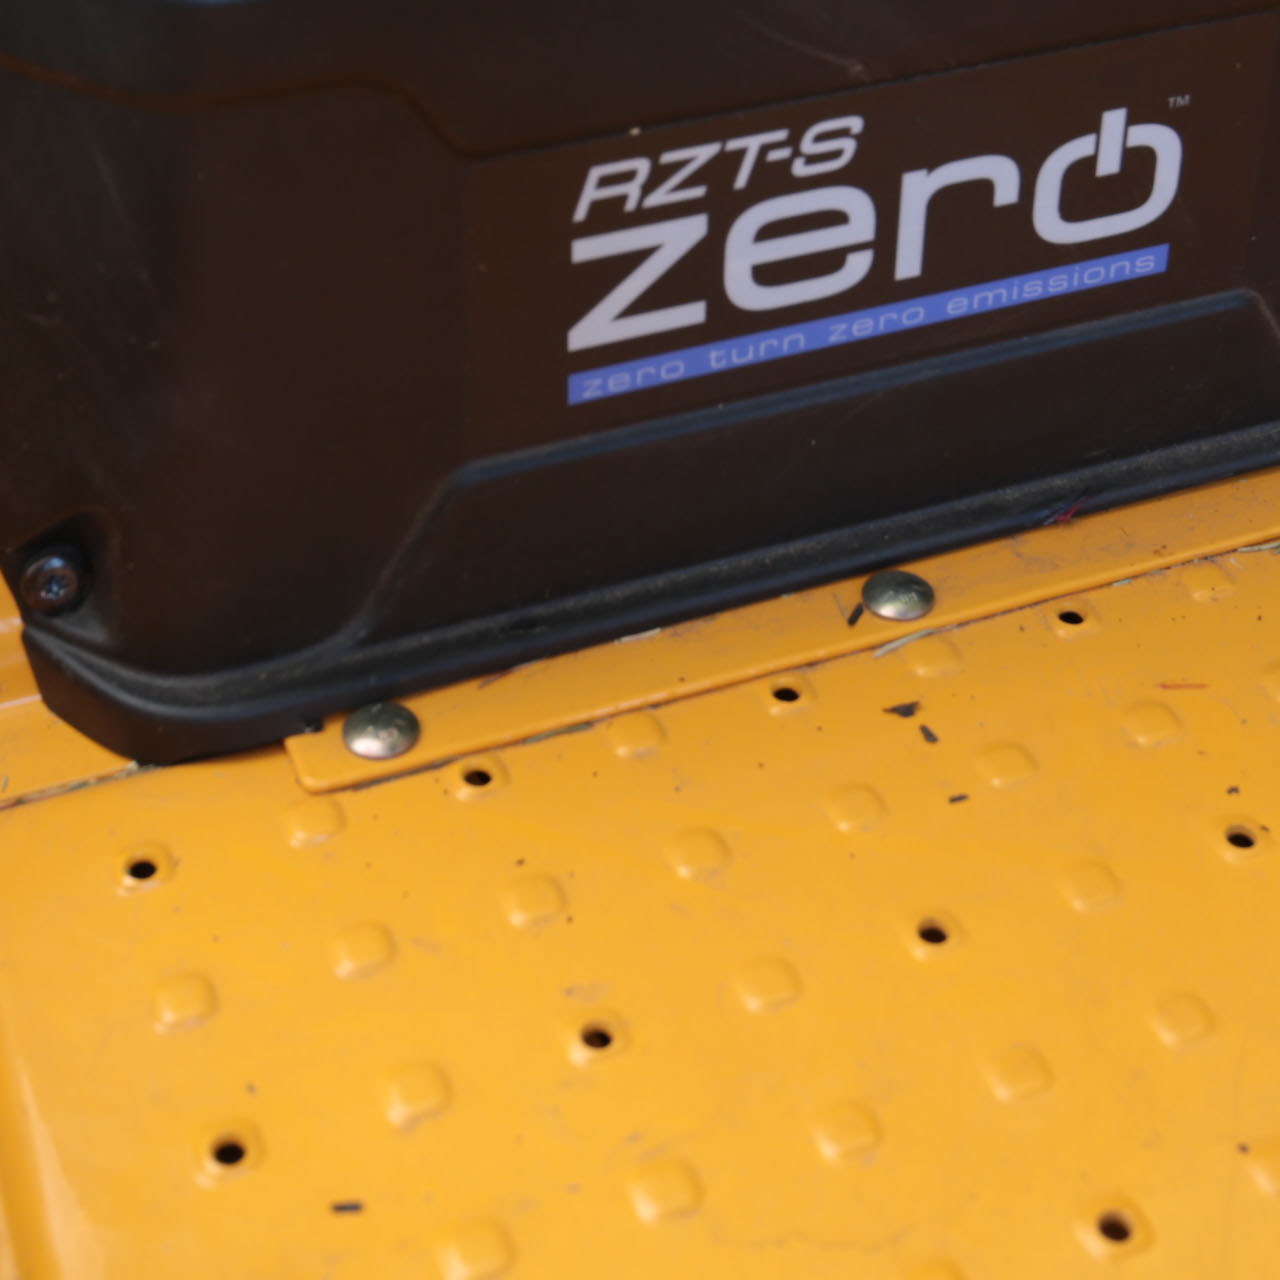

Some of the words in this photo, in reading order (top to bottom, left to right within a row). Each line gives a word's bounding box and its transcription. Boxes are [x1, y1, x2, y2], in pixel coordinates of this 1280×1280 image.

[567, 107, 1183, 352] zero
[572, 115, 864, 223] RZT-S
[582, 360, 686, 400] zero
[708, 332, 806, 370] turn
[827, 306, 926, 343] zero
[946, 255, 1156, 315] emissions
